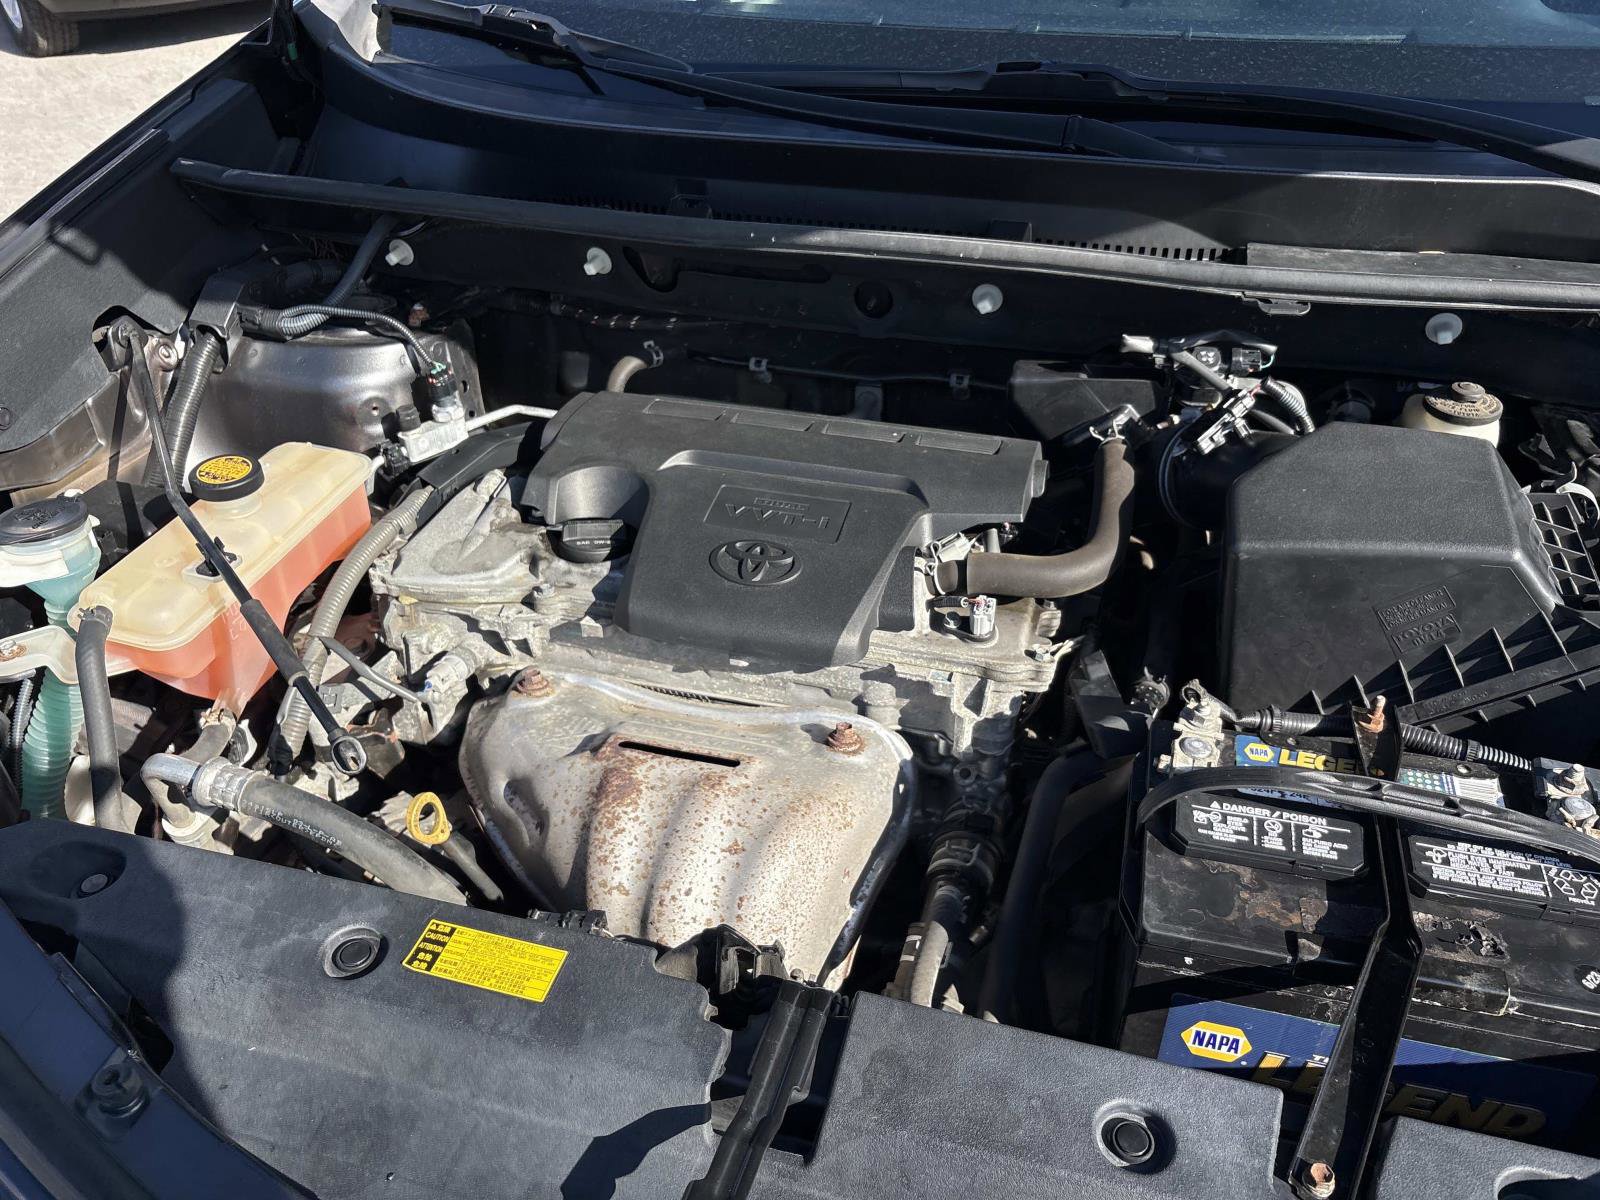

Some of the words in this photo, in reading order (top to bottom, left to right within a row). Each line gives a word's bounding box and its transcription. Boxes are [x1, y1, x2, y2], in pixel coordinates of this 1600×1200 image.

[1249, 747, 1269, 757] NAPA
[1222, 803, 1271, 817] DANGER
[1282, 812, 1327, 825] POISON
[1448, 851, 1468, 859] FLUSH
[1488, 858, 1531, 869] IMMEDIATELY
[1498, 869, 1515, 877] FAST
[425, 932, 450, 942] CAUTION
[1191, 1029, 1241, 1055] NAPA
